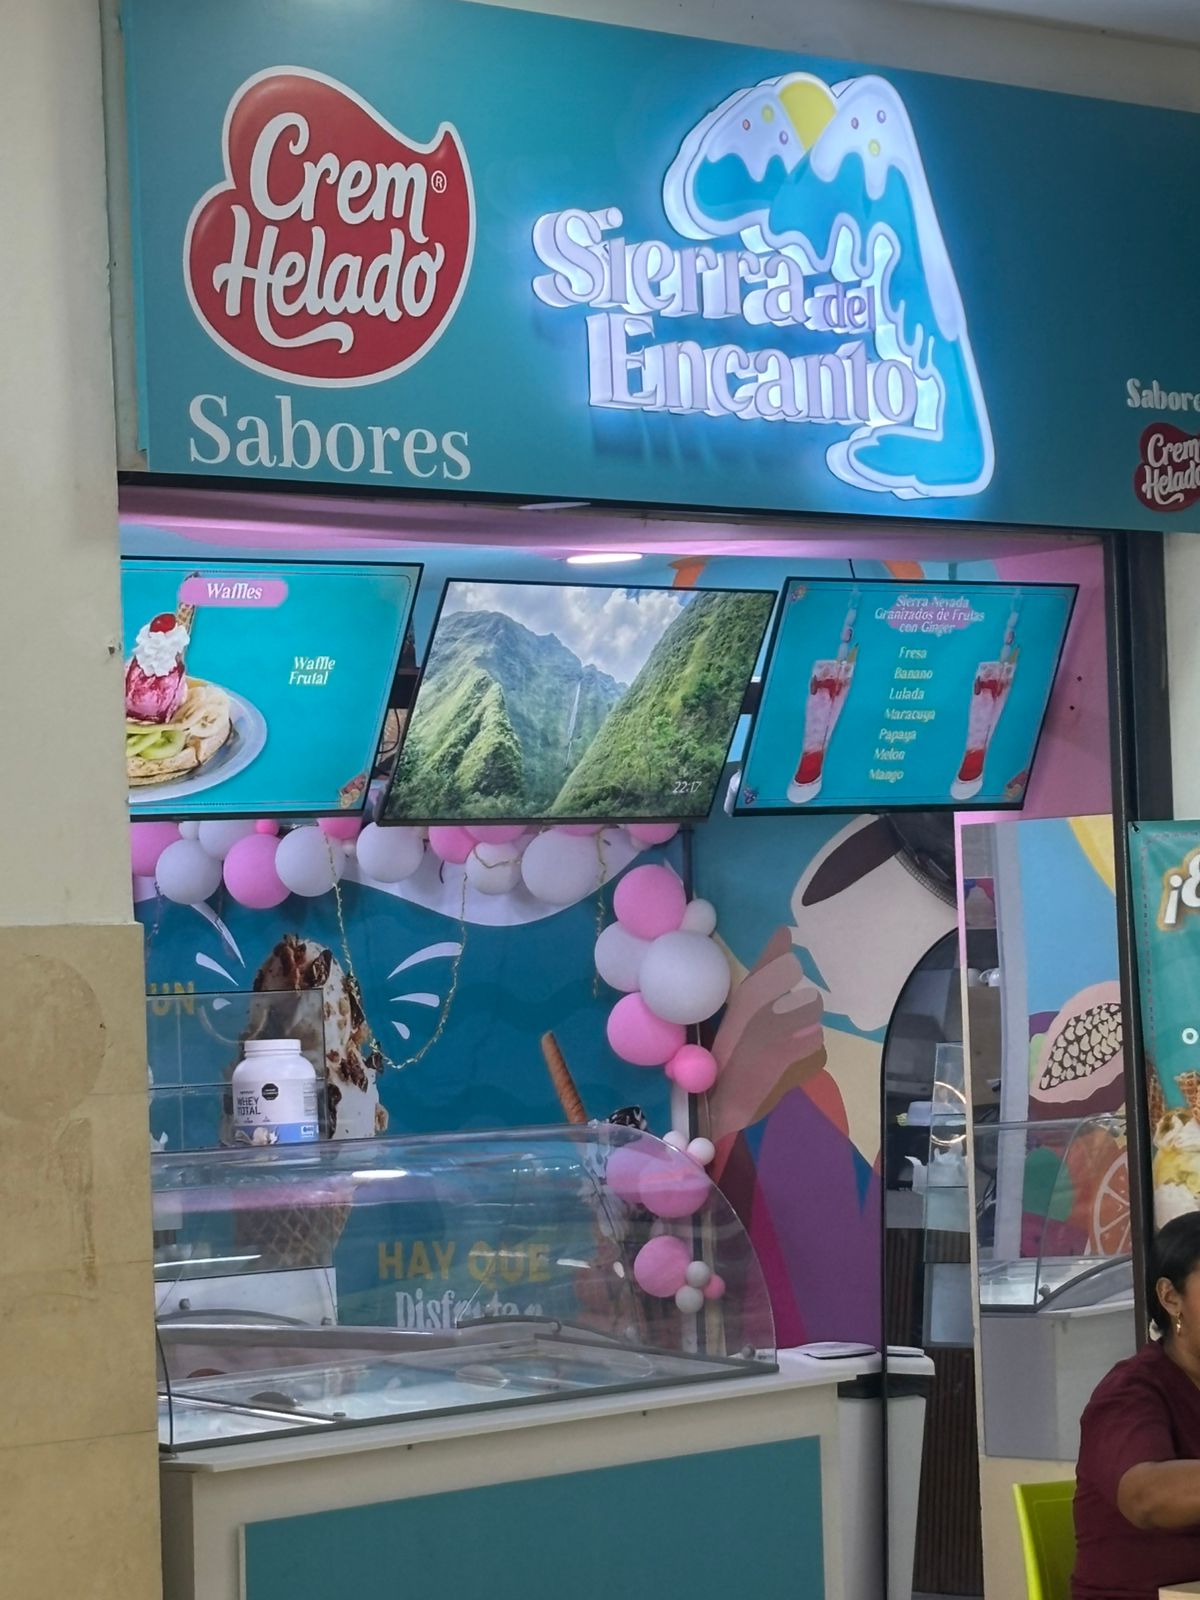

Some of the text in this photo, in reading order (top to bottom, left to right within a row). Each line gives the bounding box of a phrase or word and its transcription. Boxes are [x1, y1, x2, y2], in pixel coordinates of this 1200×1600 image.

[250, 112, 428, 243] Crem
[532, 206, 876, 333] Sierra del
[213, 205, 444, 353] Helado
[587, 312, 918, 425] Encanto
[188, 393, 471, 480] Sabores
[1147, 433, 1200, 468] Crem
[207, 582, 263, 600] Waffles
[896, 594, 970, 609] Sierra Nevada
[874, 607, 985, 621] Granizados de Frutas
[899, 621, 957, 637] con Ginger
[899, 646, 928, 659] Fresa
[294, 656, 336, 670] Waffle
[288, 671, 329, 685] Frutal
[894, 667, 933, 680] Banano
[889, 687, 925, 700] Lulada
[879, 728, 917, 743] Papaya
[868, 769, 905, 783] Mango
[672, 780, 702, 794] 22:17
[237, 1096, 260, 1106] WHEY
[237, 1106, 261, 1116] TOTAL
[378, 1240, 551, 1289] HAY QUE
